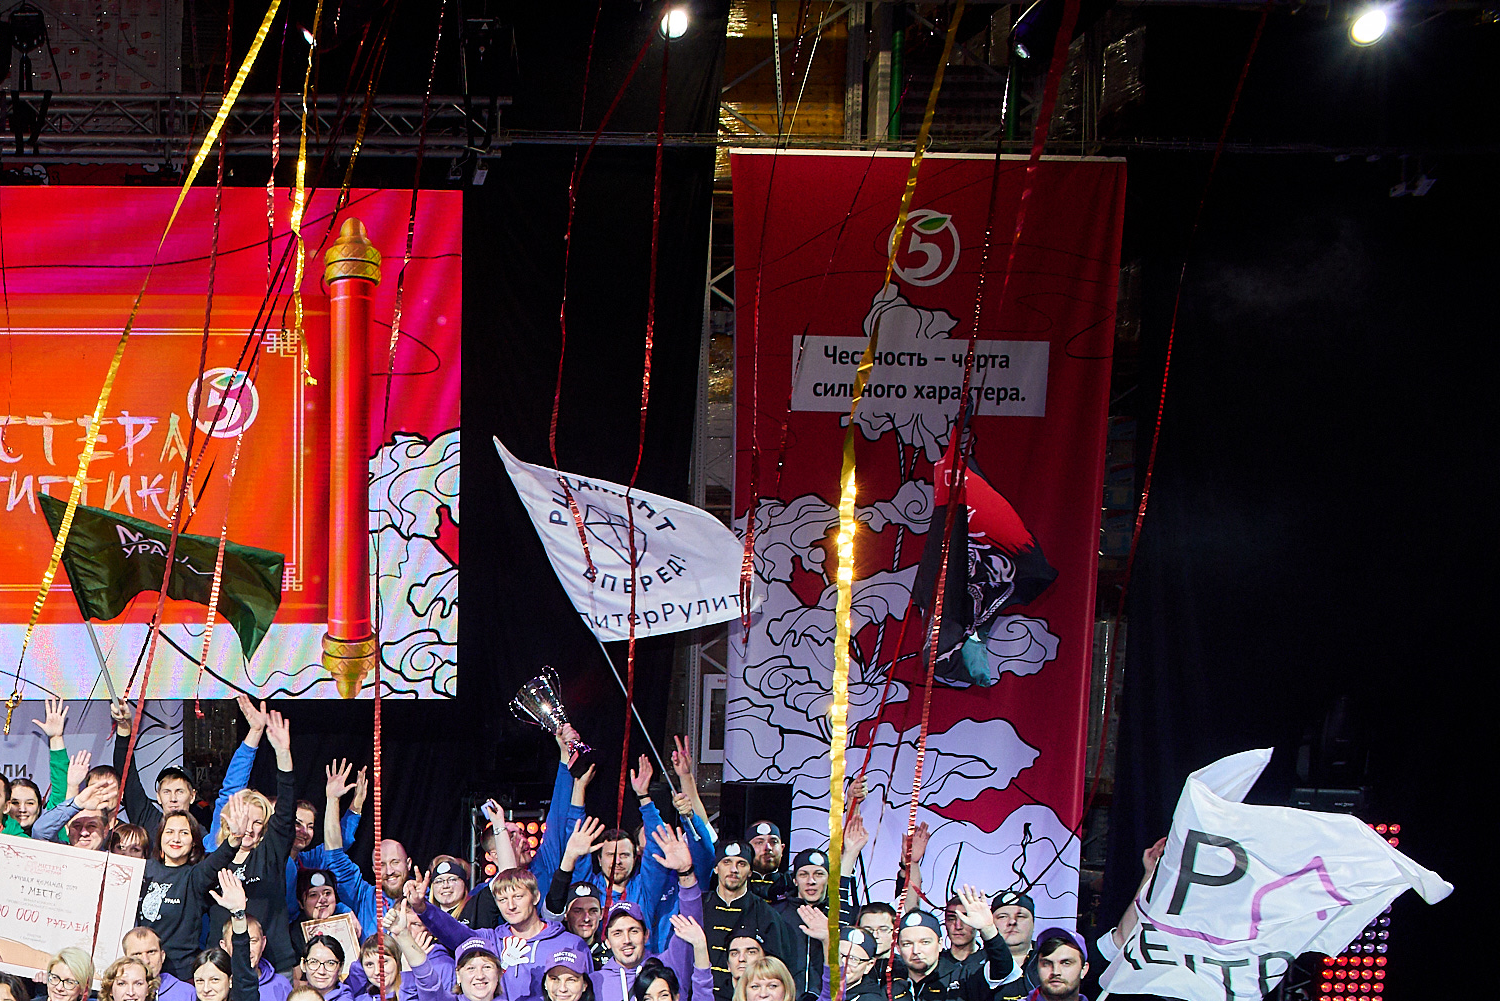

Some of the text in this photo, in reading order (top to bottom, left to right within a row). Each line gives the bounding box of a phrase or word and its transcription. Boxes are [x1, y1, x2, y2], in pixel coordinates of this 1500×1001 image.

[824, 344, 928, 367] Чесность
[28, 886, 62, 899] МЕСТО
[16, 908, 40, 923] 000
[46, 917, 90, 933] РУБЛЕЙ
